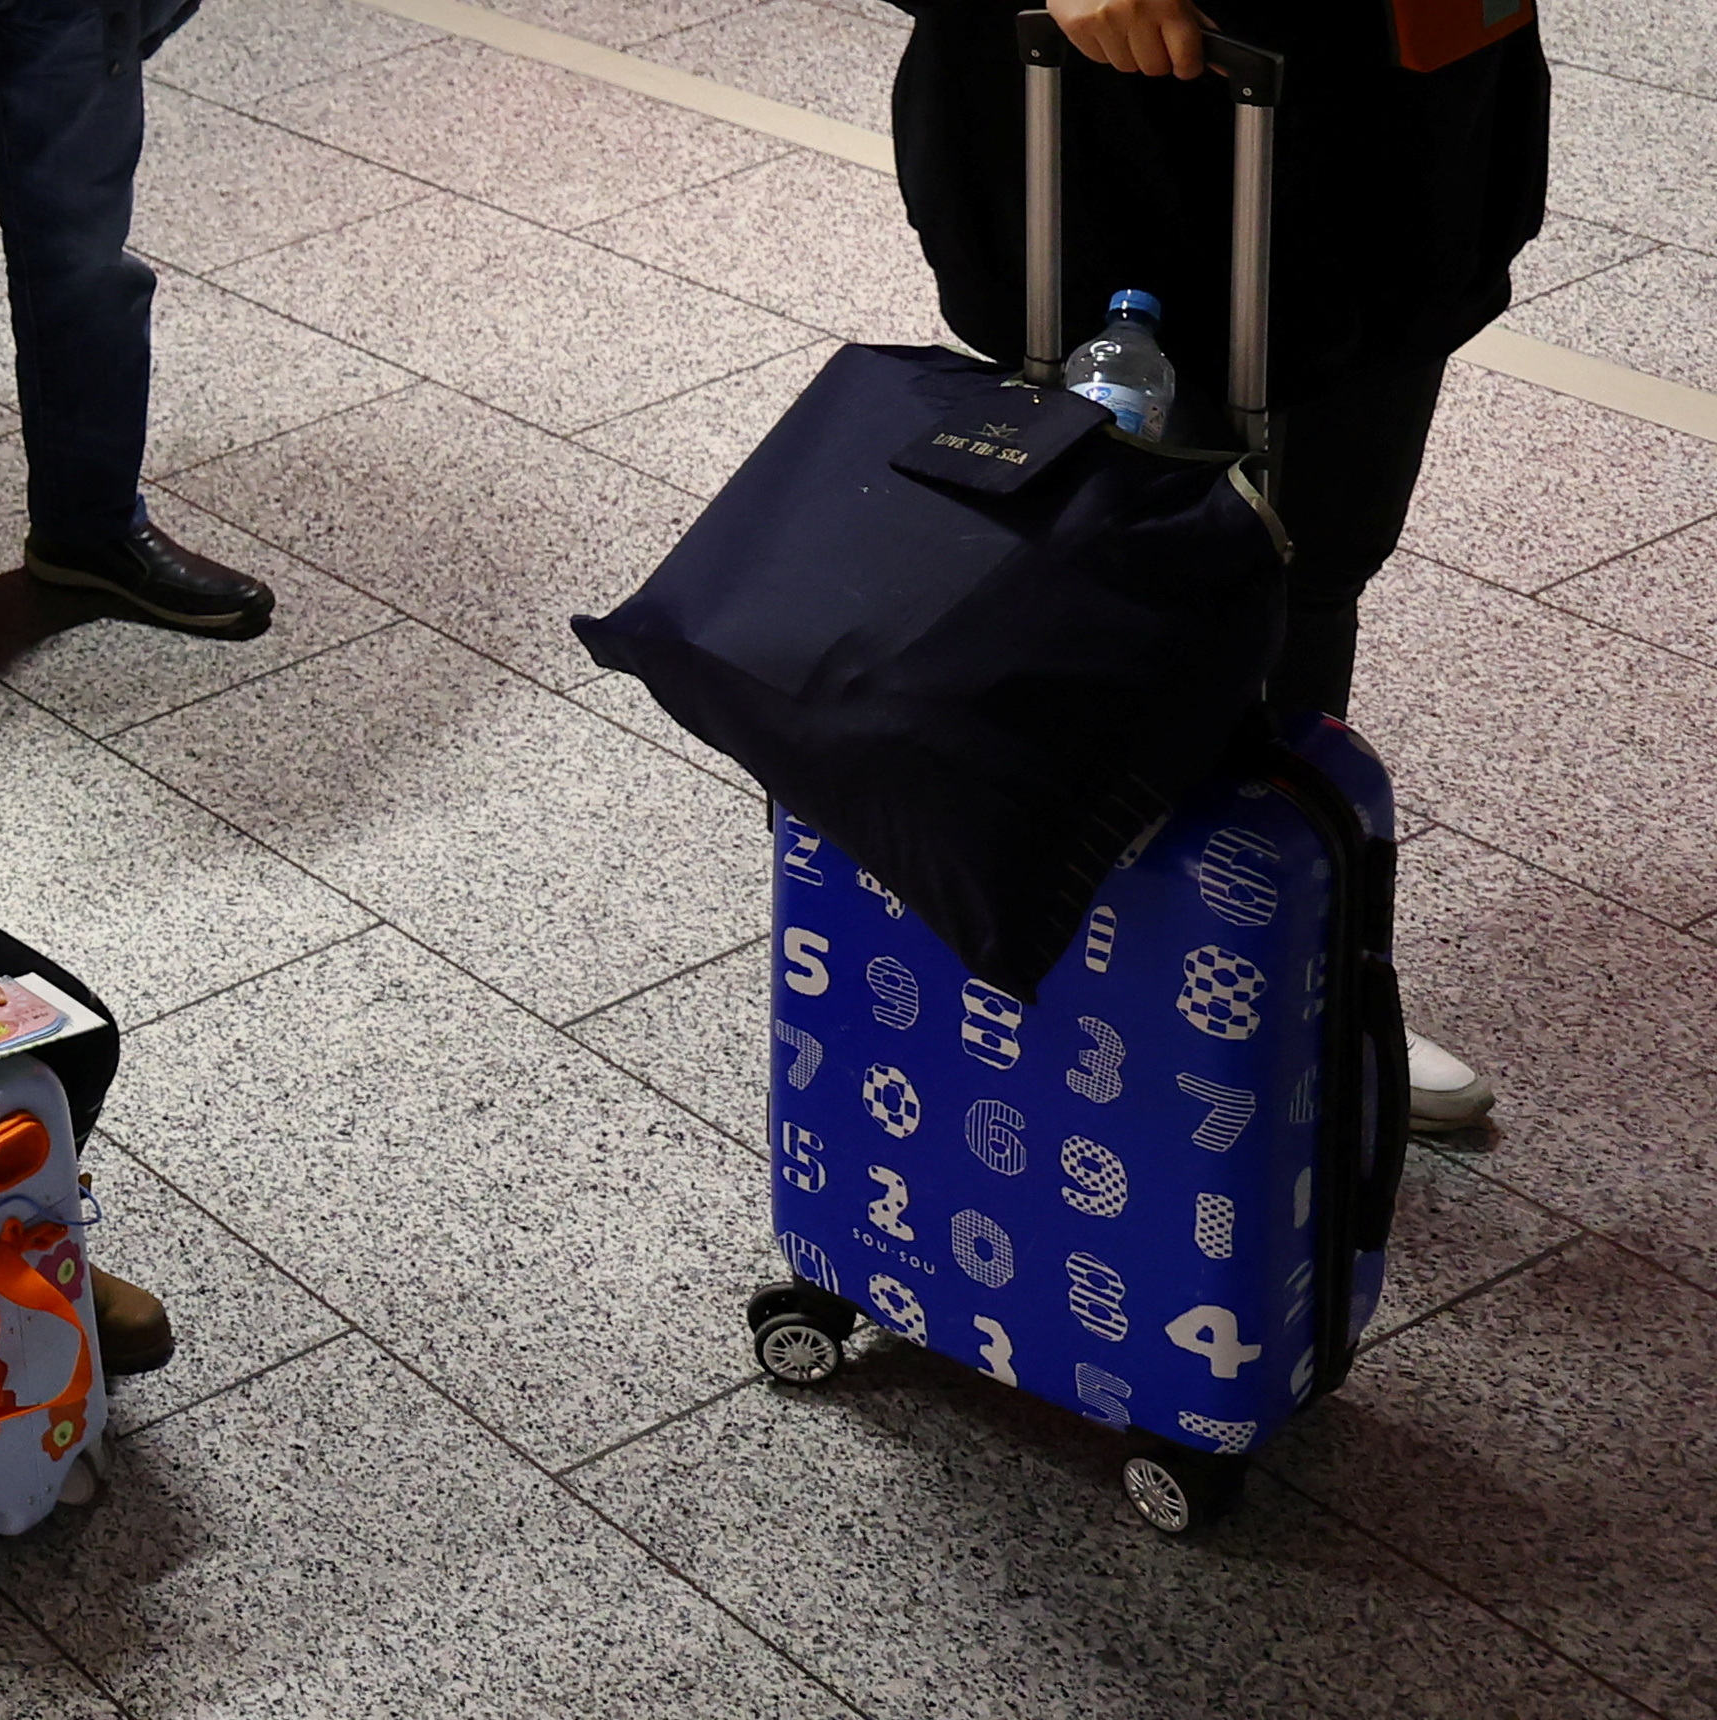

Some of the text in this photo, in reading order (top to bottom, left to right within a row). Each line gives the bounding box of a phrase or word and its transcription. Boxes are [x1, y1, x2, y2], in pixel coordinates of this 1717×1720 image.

[931, 432, 1029, 466] LOVE THE SEA
[1198, 826, 1282, 927] 6
[866, 955, 919, 1031] 9
[961, 977, 1023, 1071] 8
[1175, 943, 1267, 1041] 8
[775, 1017, 824, 1092] 7
[1066, 1015, 1126, 1104] 3
[862, 1062, 922, 1139] 0
[964, 1099, 1027, 1176] 6
[1175, 1070, 1256, 1153] 7
[781, 1120, 826, 1194] 5
[1060, 1134, 1129, 1218] 9
[867, 1164, 916, 1242] 2
[951, 1207, 1014, 1289] 0
[1065, 1250, 1129, 1343] 8
[1164, 1304, 1262, 1379] 4
